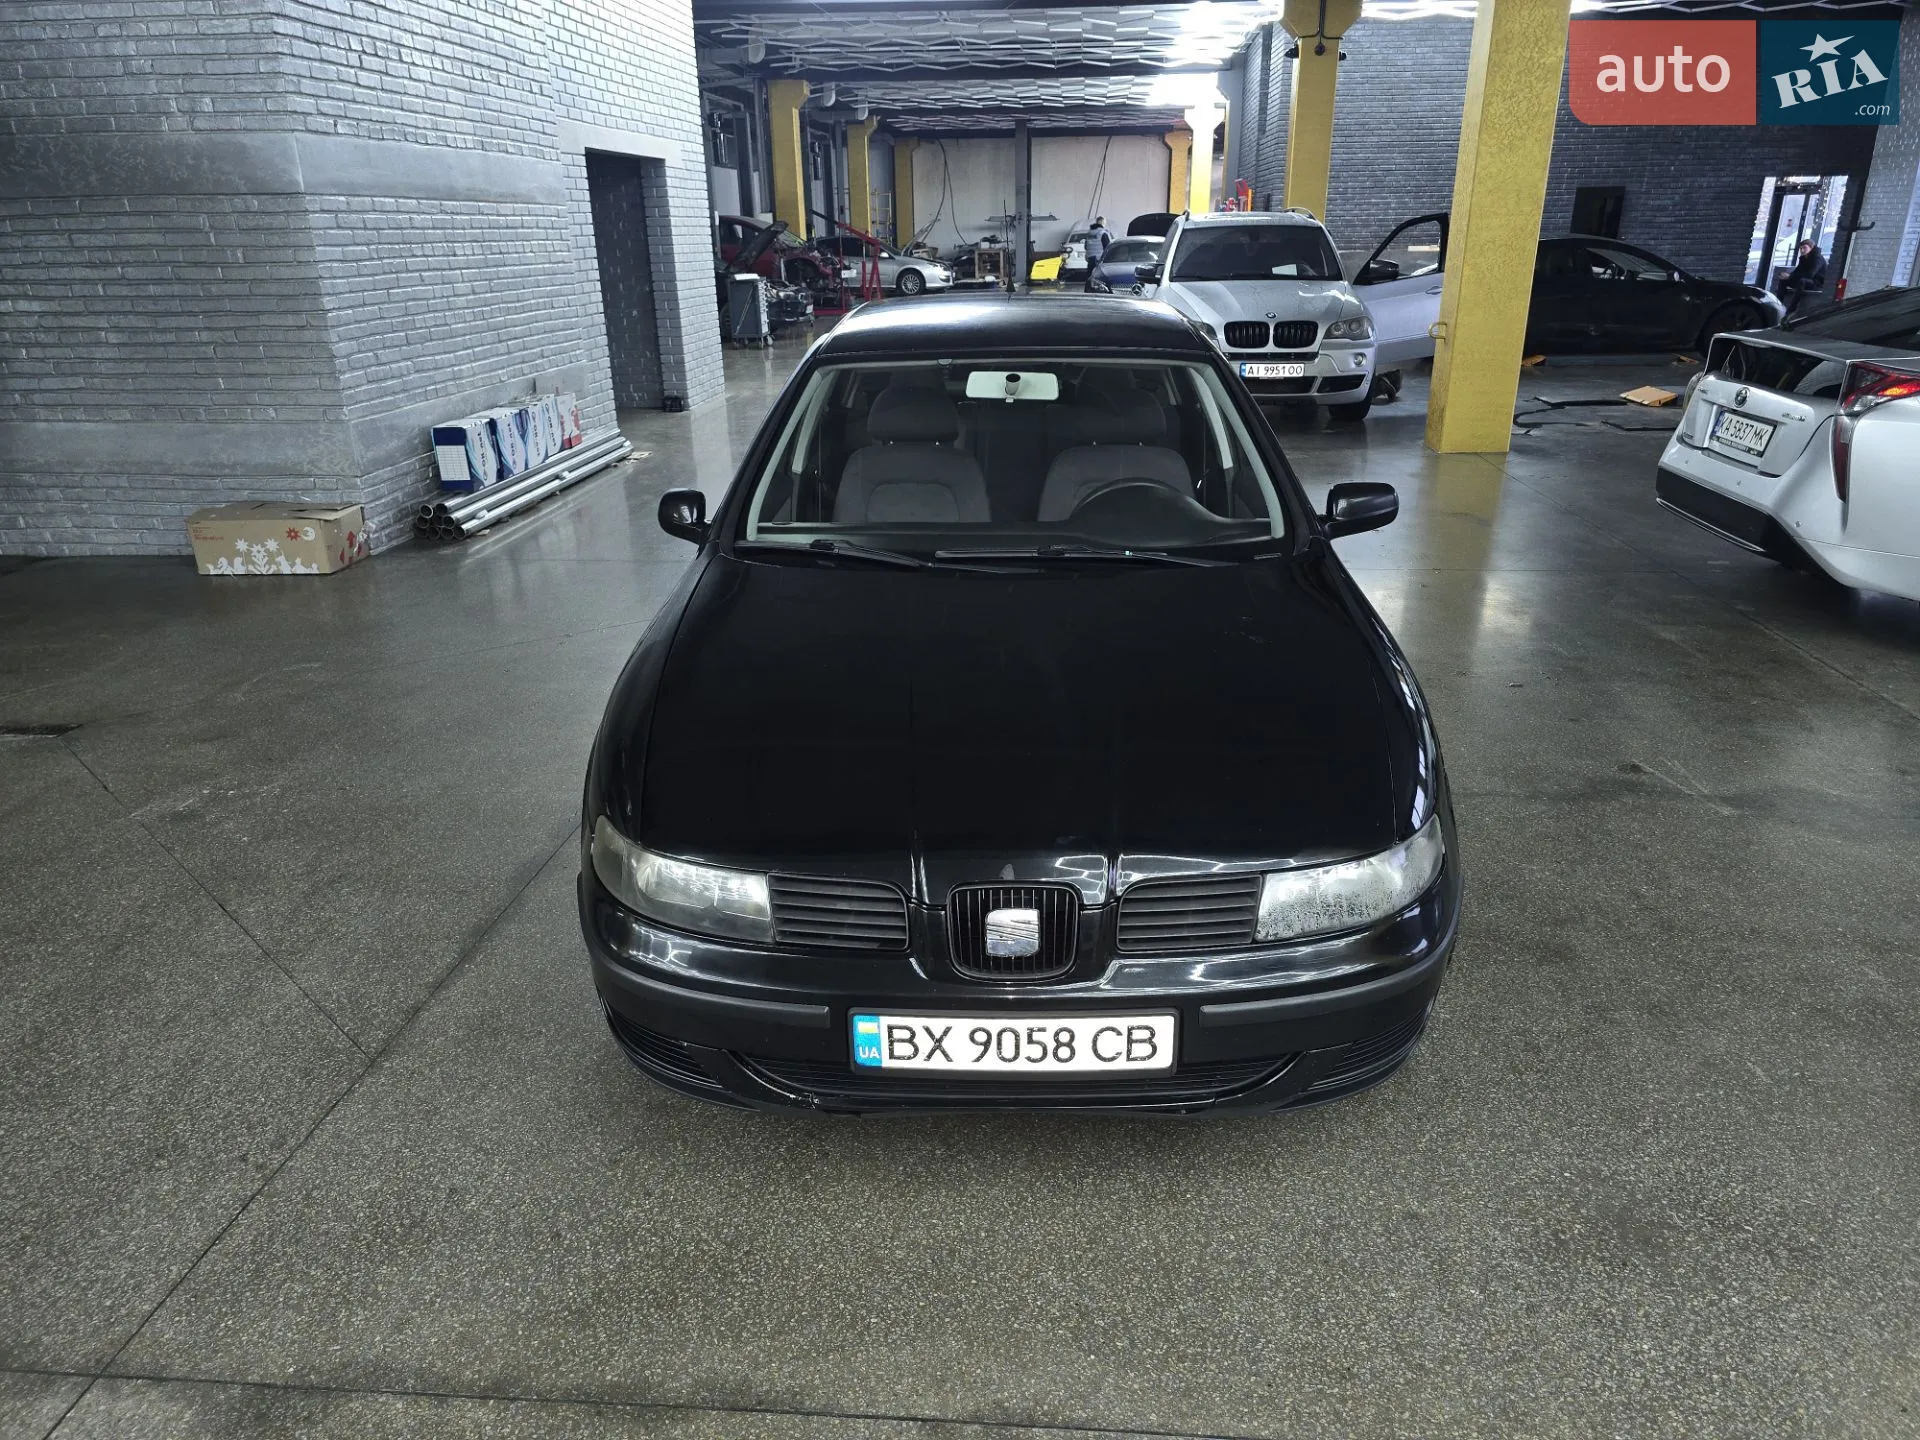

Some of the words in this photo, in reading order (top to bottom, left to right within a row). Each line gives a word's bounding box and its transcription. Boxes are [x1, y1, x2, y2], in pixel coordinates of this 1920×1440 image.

[1247, 366, 1260, 375] AI
[1264, 366, 1286, 376] 9951
[1719, 415, 1732, 436] KA
[1750, 426, 1768, 447] MK
[859, 1047, 880, 1059] UA
[887, 1024, 953, 1062] BX
[968, 1026, 1076, 1063] 9058
[1091, 1025, 1158, 1063] CB
